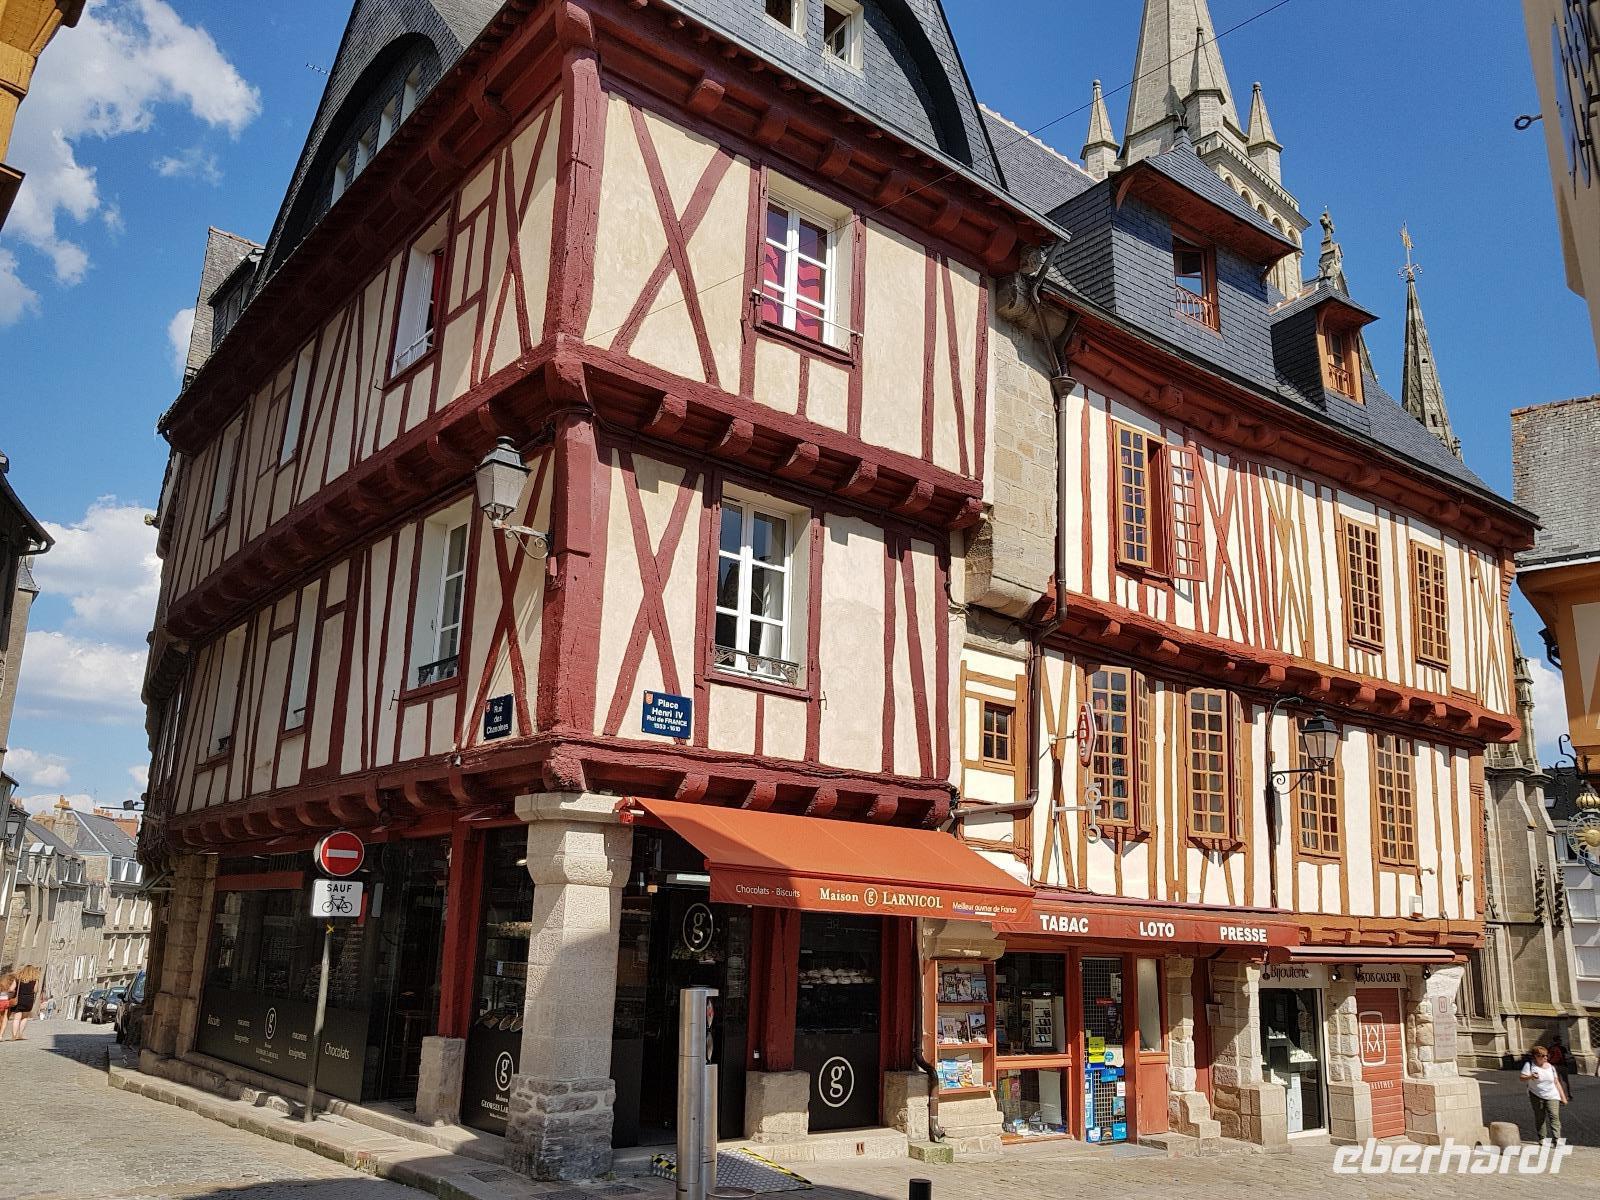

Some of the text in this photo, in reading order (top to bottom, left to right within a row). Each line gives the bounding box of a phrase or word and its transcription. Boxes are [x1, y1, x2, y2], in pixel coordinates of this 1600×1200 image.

[657, 698, 679, 710] Place
[646, 714, 657, 722] Roi
[664, 717, 688, 727] FRANCE
[651, 707, 684, 719] Henri IV
[1079, 711, 1087, 757] TABAC
[326, 883, 353, 893] SAUF
[735, 884, 770, 895] Chocolats
[775, 887, 801, 898] Biscuits
[819, 887, 859, 902] Maison
[882, 891, 943, 909] LARNICOL
[992, 905, 1001, 913] de
[1040, 914, 1089, 933] TABAC
[1139, 921, 1175, 938] LOTO
[1219, 926, 1268, 943] PRESSE
[1376, 972, 1401, 983] GAUCHER
[324, 1042, 350, 1060] Chocolats
